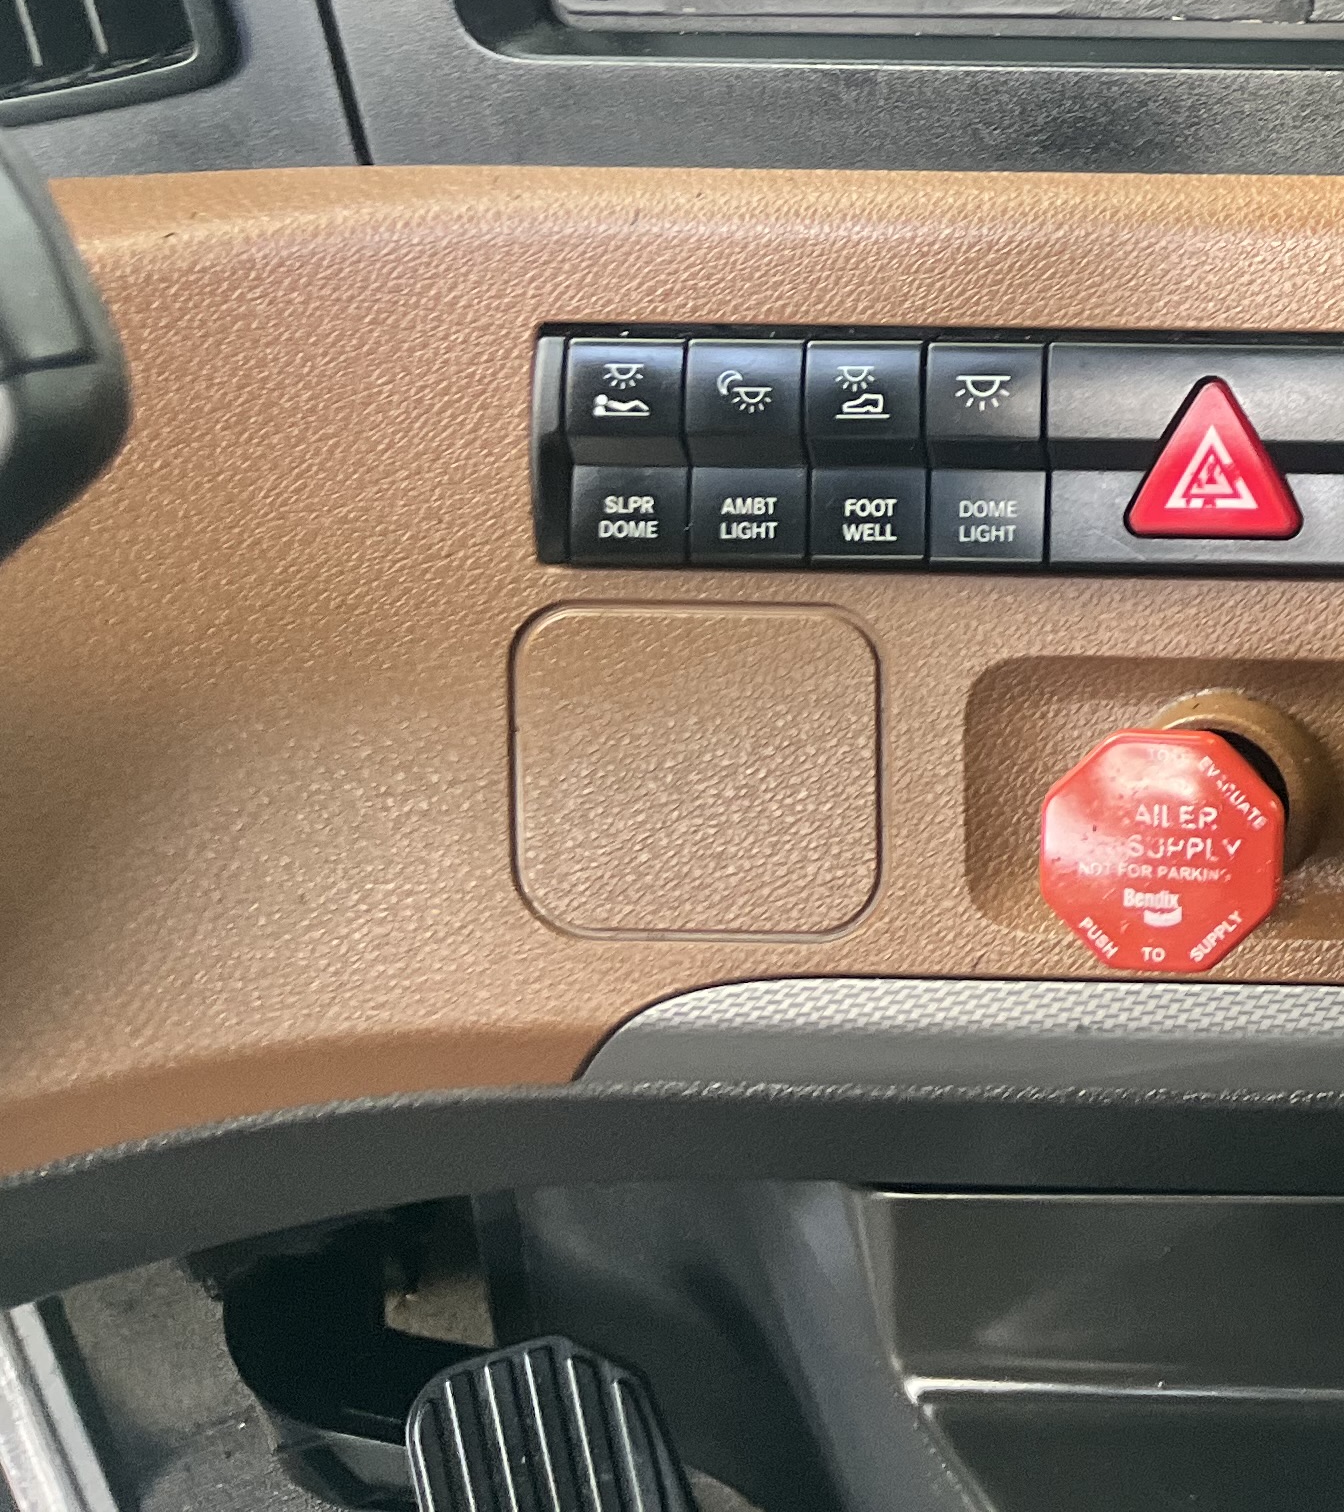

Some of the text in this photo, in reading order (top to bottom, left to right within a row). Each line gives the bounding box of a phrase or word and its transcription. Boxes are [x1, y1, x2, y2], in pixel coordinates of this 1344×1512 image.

[604, 495, 655, 515] SLPR
[720, 496, 777, 516] AMBT
[844, 498, 897, 518] FOOT
[958, 500, 1018, 519] DOME
[598, 519, 658, 539] DOME
[719, 521, 777, 540] LIGHT
[842, 522, 897, 542] WELL
[958, 524, 1016, 544] LIGHT
[1117, 863, 1152, 879] FOR
[1123, 887, 1180, 909] Bendix
[1079, 910, 1243, 963] PUSH TO SUPPLY
